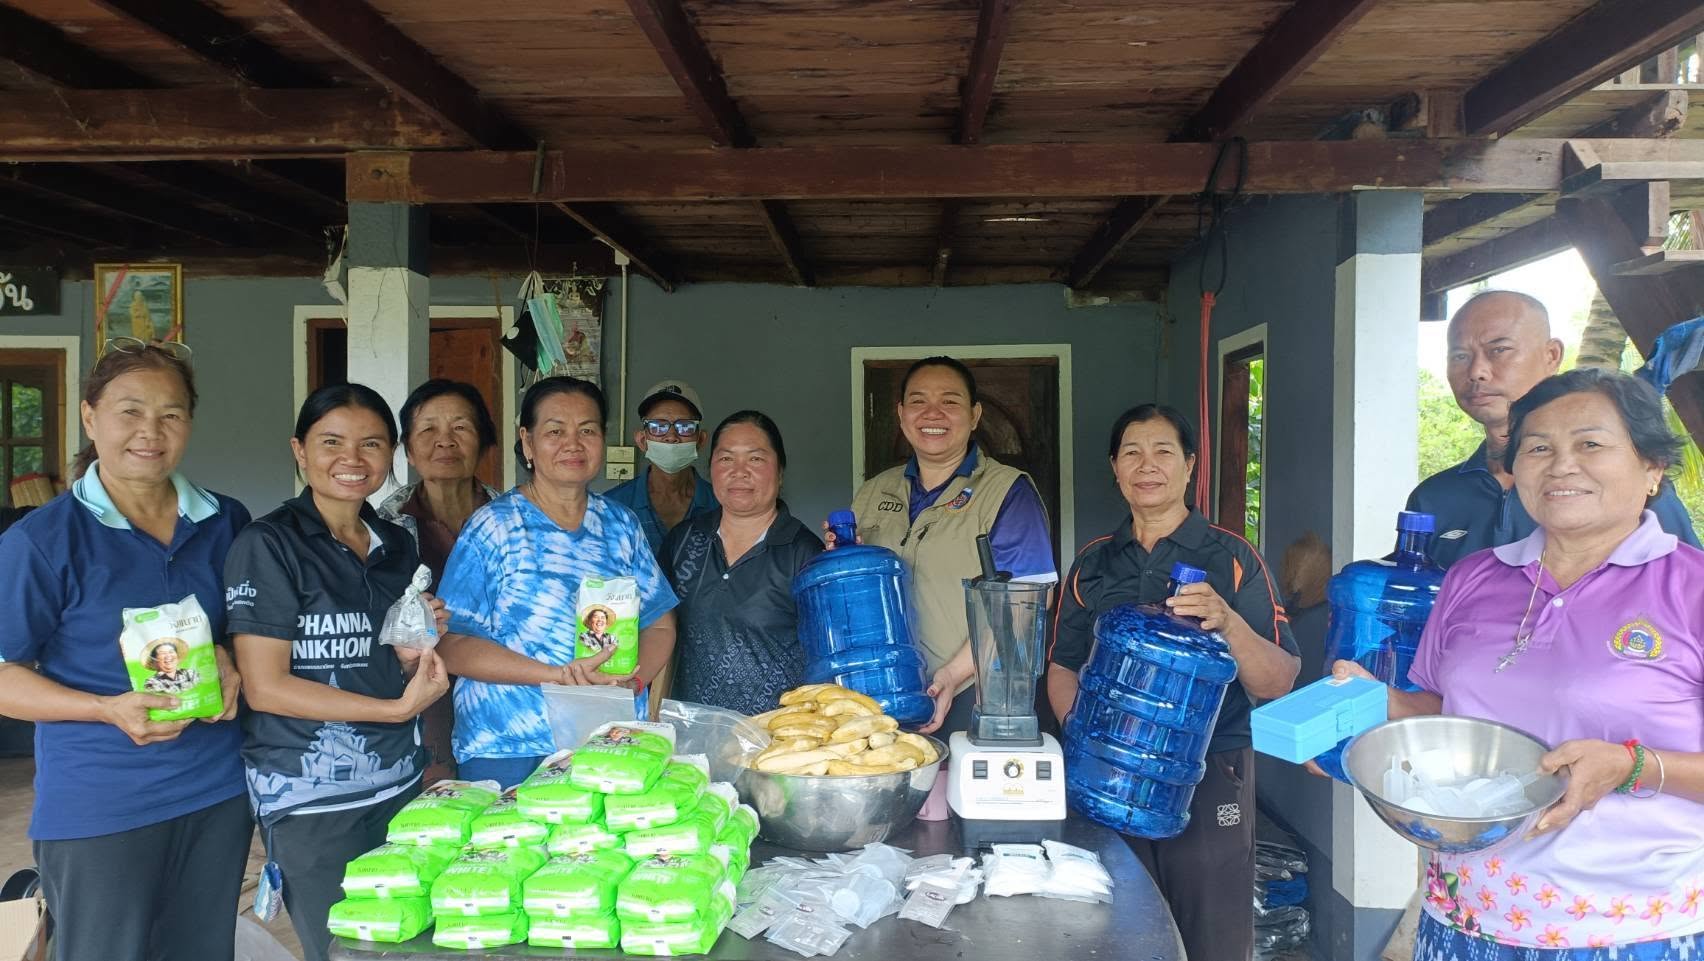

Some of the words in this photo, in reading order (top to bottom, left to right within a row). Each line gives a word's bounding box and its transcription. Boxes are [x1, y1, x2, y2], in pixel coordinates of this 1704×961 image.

[877, 501, 903, 513] CDD
[297, 612, 372, 636] PHANNA
[292, 636, 372, 660] NIKHOM
